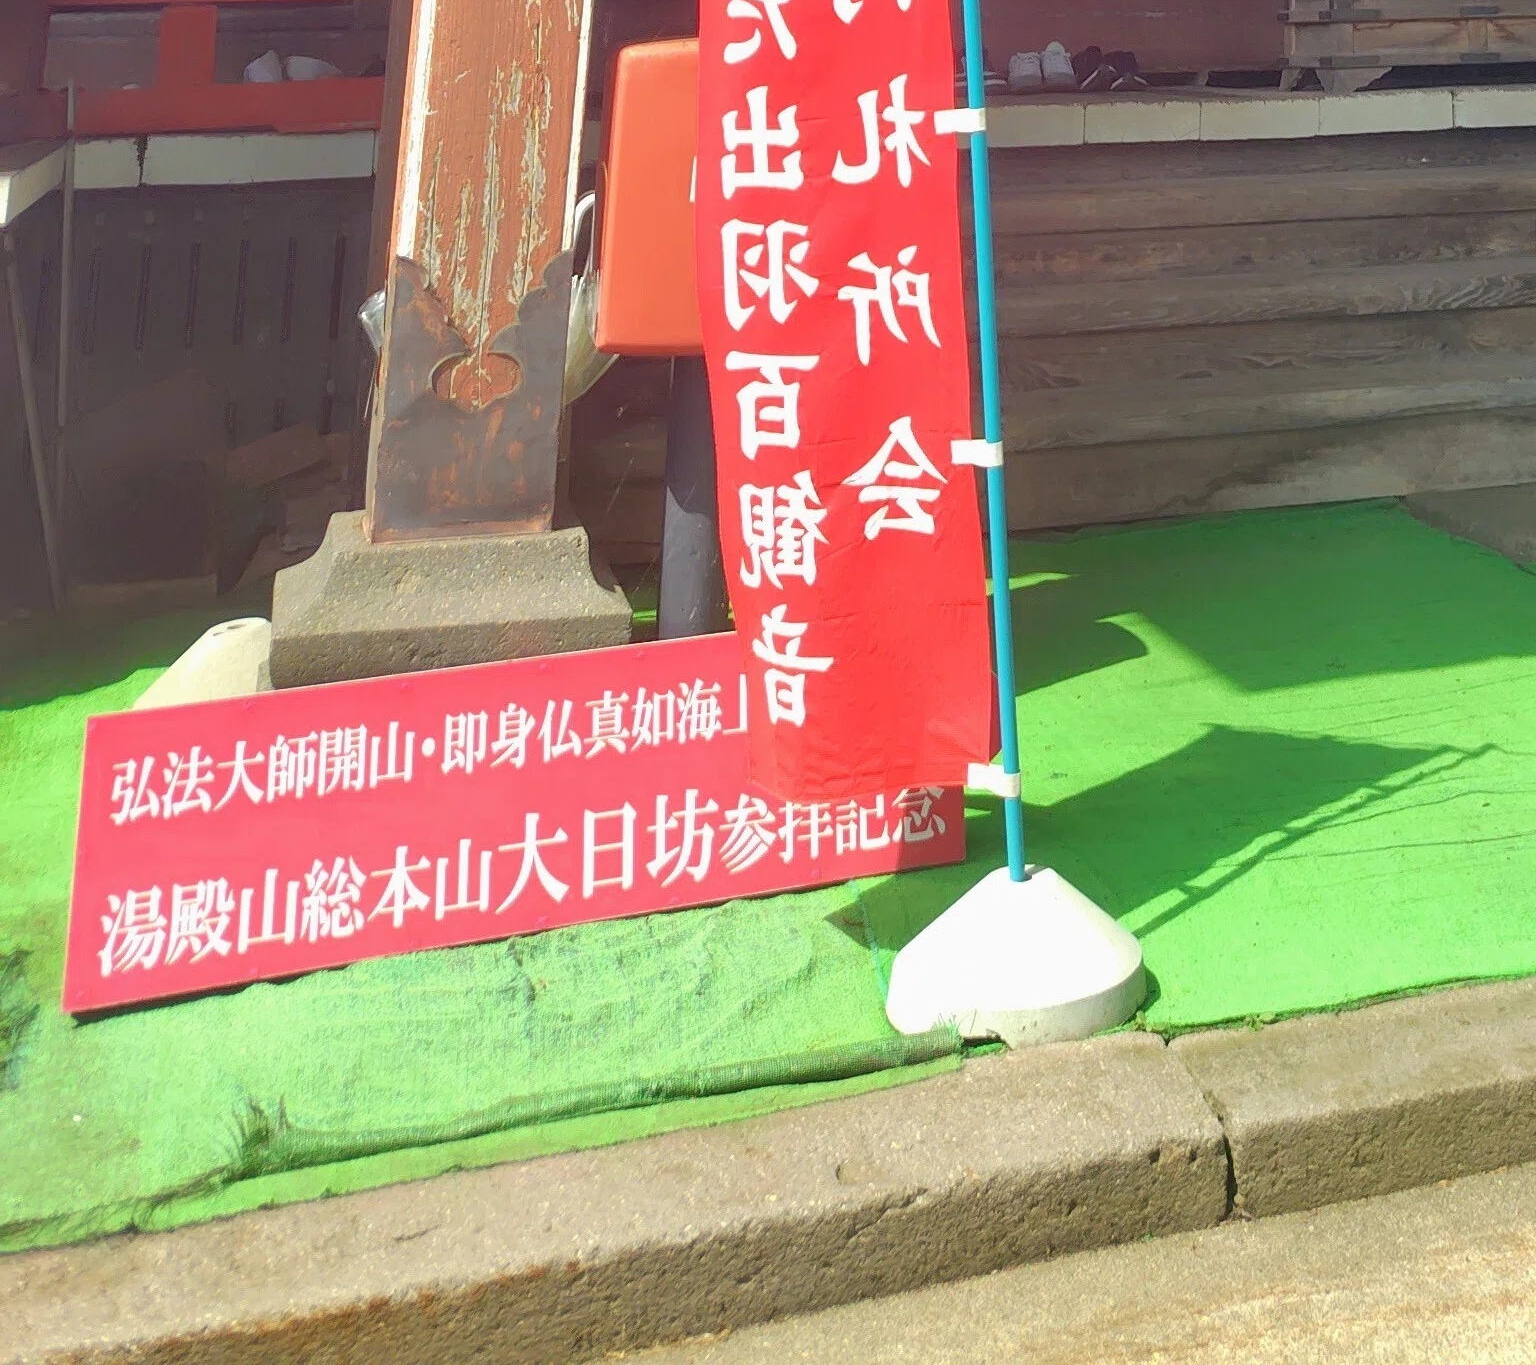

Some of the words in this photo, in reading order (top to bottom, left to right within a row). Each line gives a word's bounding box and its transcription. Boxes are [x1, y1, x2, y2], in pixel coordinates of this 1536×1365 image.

[97, 785, 946, 977] 湯殿山総本山大日坊参拝記念
